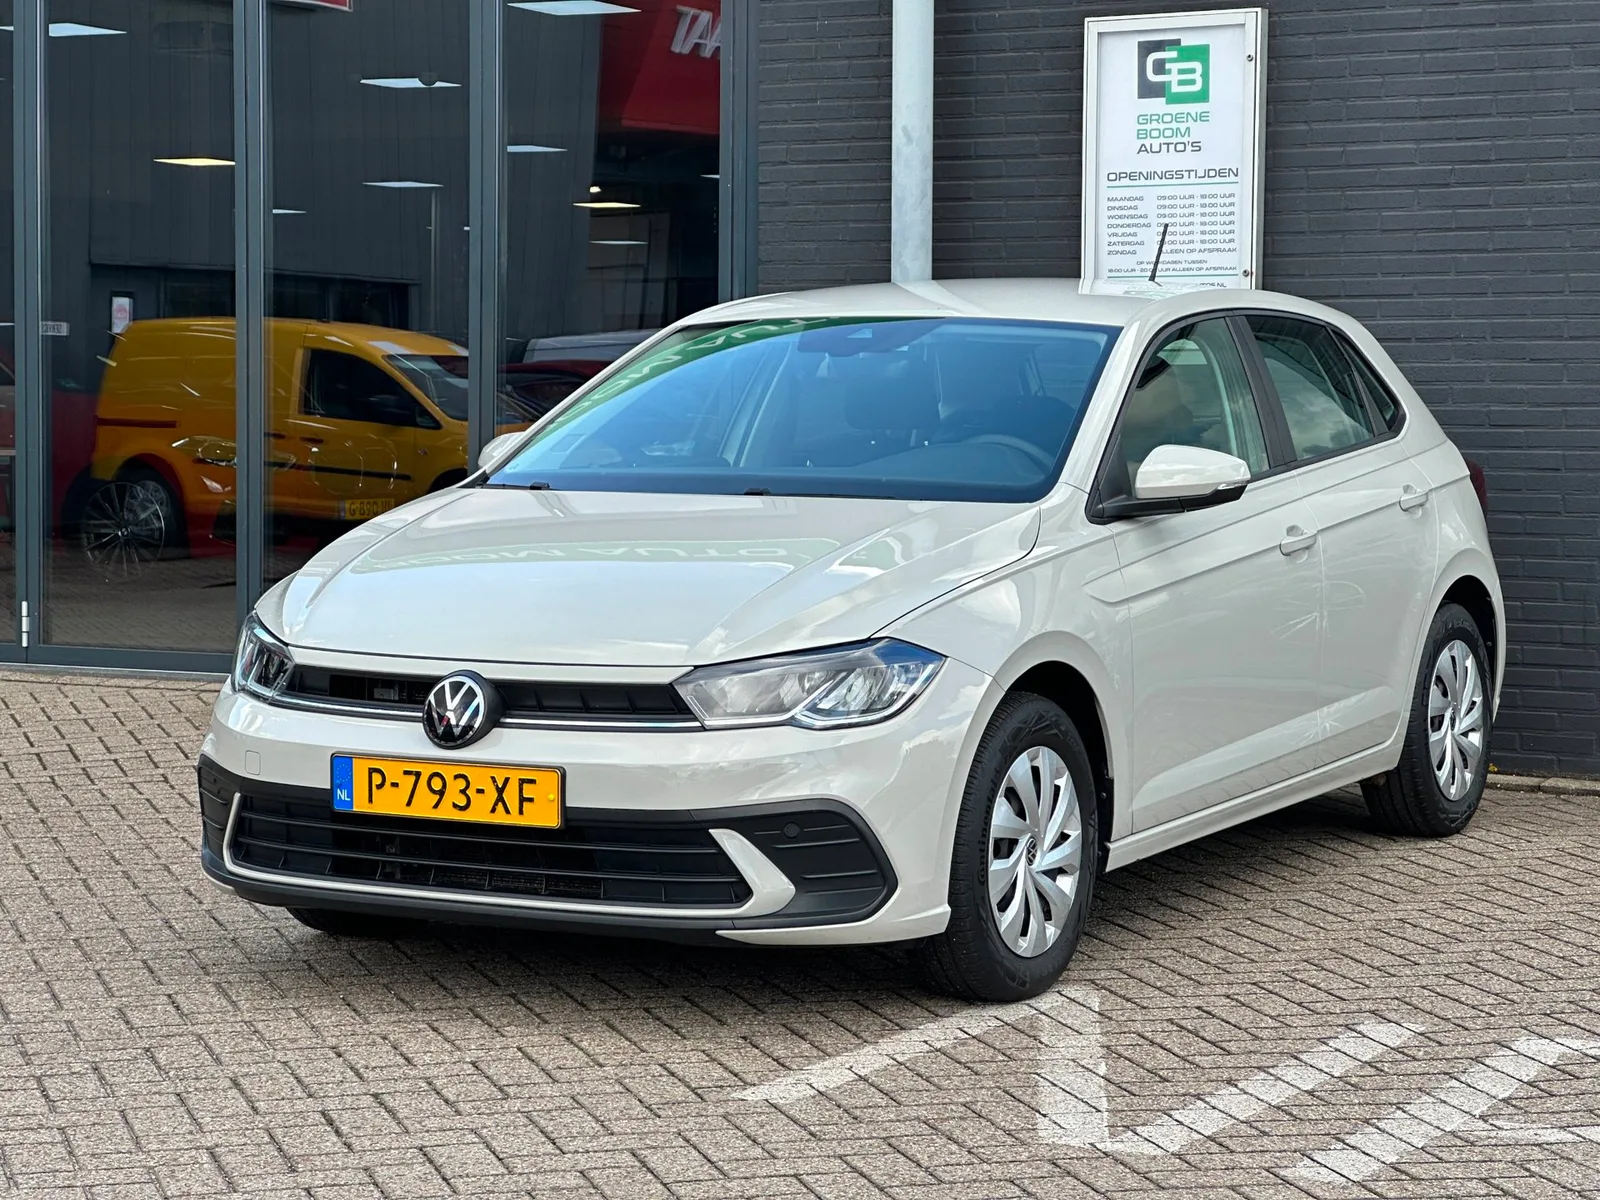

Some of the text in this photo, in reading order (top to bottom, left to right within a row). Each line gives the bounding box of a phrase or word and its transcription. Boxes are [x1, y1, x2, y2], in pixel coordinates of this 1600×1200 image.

[1137, 111, 1210, 125] GROENE
[1136, 127, 1191, 140] BOOM
[1137, 141, 1202, 154] AUTO'S
[1107, 168, 1239, 182] OPENINGSTIJDEN
[337, 788, 350, 801] NL
[367, 767, 537, 816] P-793-XF
